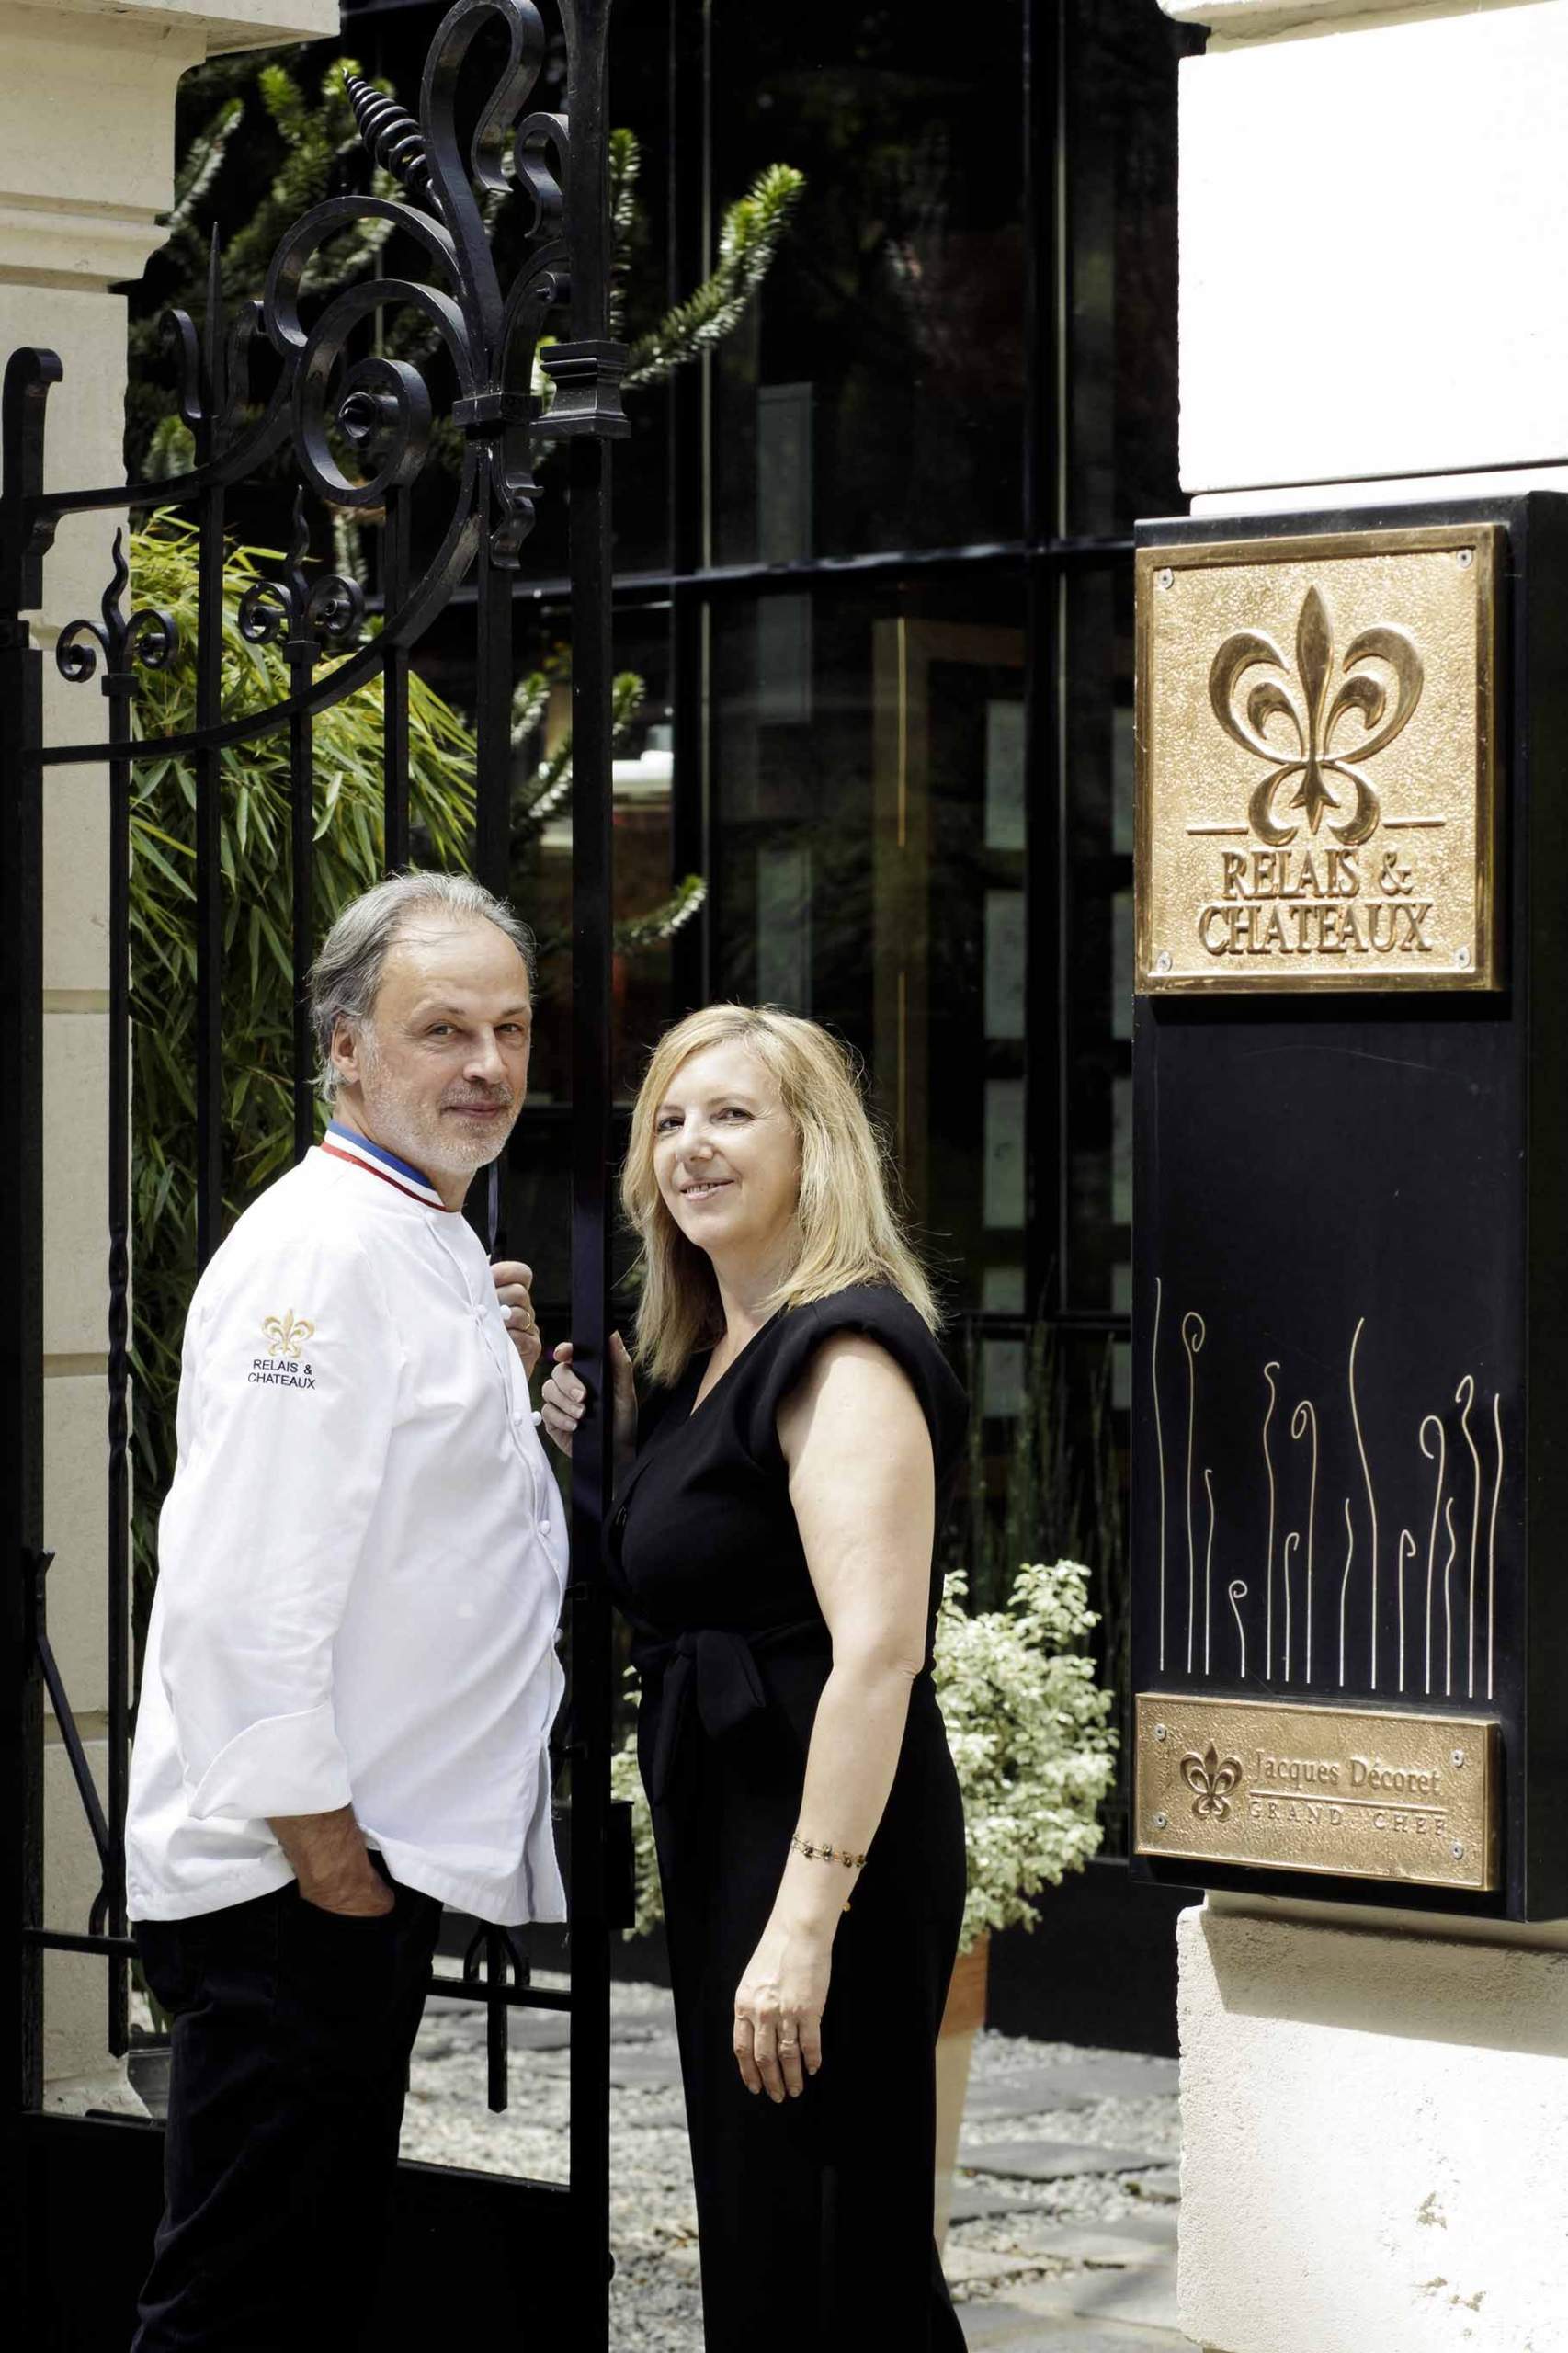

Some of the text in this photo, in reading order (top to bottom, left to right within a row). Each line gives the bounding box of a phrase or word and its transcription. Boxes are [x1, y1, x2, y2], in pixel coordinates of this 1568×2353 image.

[1221, 847, 1415, 900] RELAIS &
[1198, 902, 1434, 956] CHATEAUX
[247, 1371, 316, 1390] CHATEAUX
[253, 1358, 312, 1376] RELAIS &
[1253, 1749, 1442, 1795] Jacques Décoret
[1249, 1800, 1447, 1838] GRAND CHEF
